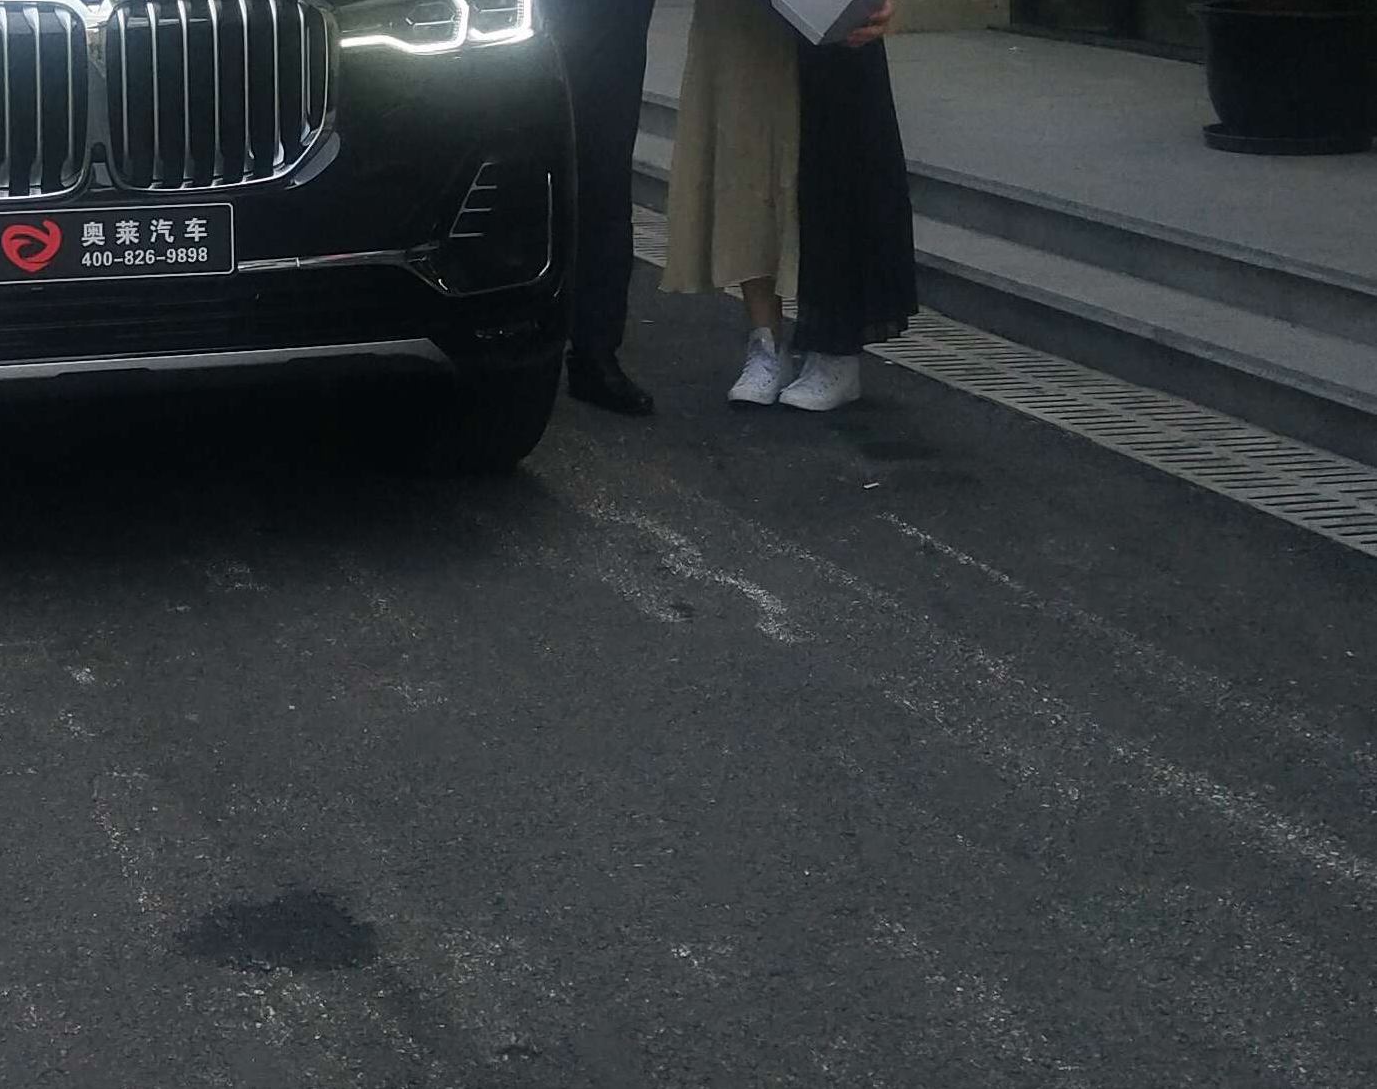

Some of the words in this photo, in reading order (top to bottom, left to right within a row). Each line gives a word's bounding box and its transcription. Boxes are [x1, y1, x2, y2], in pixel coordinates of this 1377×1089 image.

[81, 218, 208, 247] 奥莱汽车
[81, 247, 208, 267] 400-826-9898
